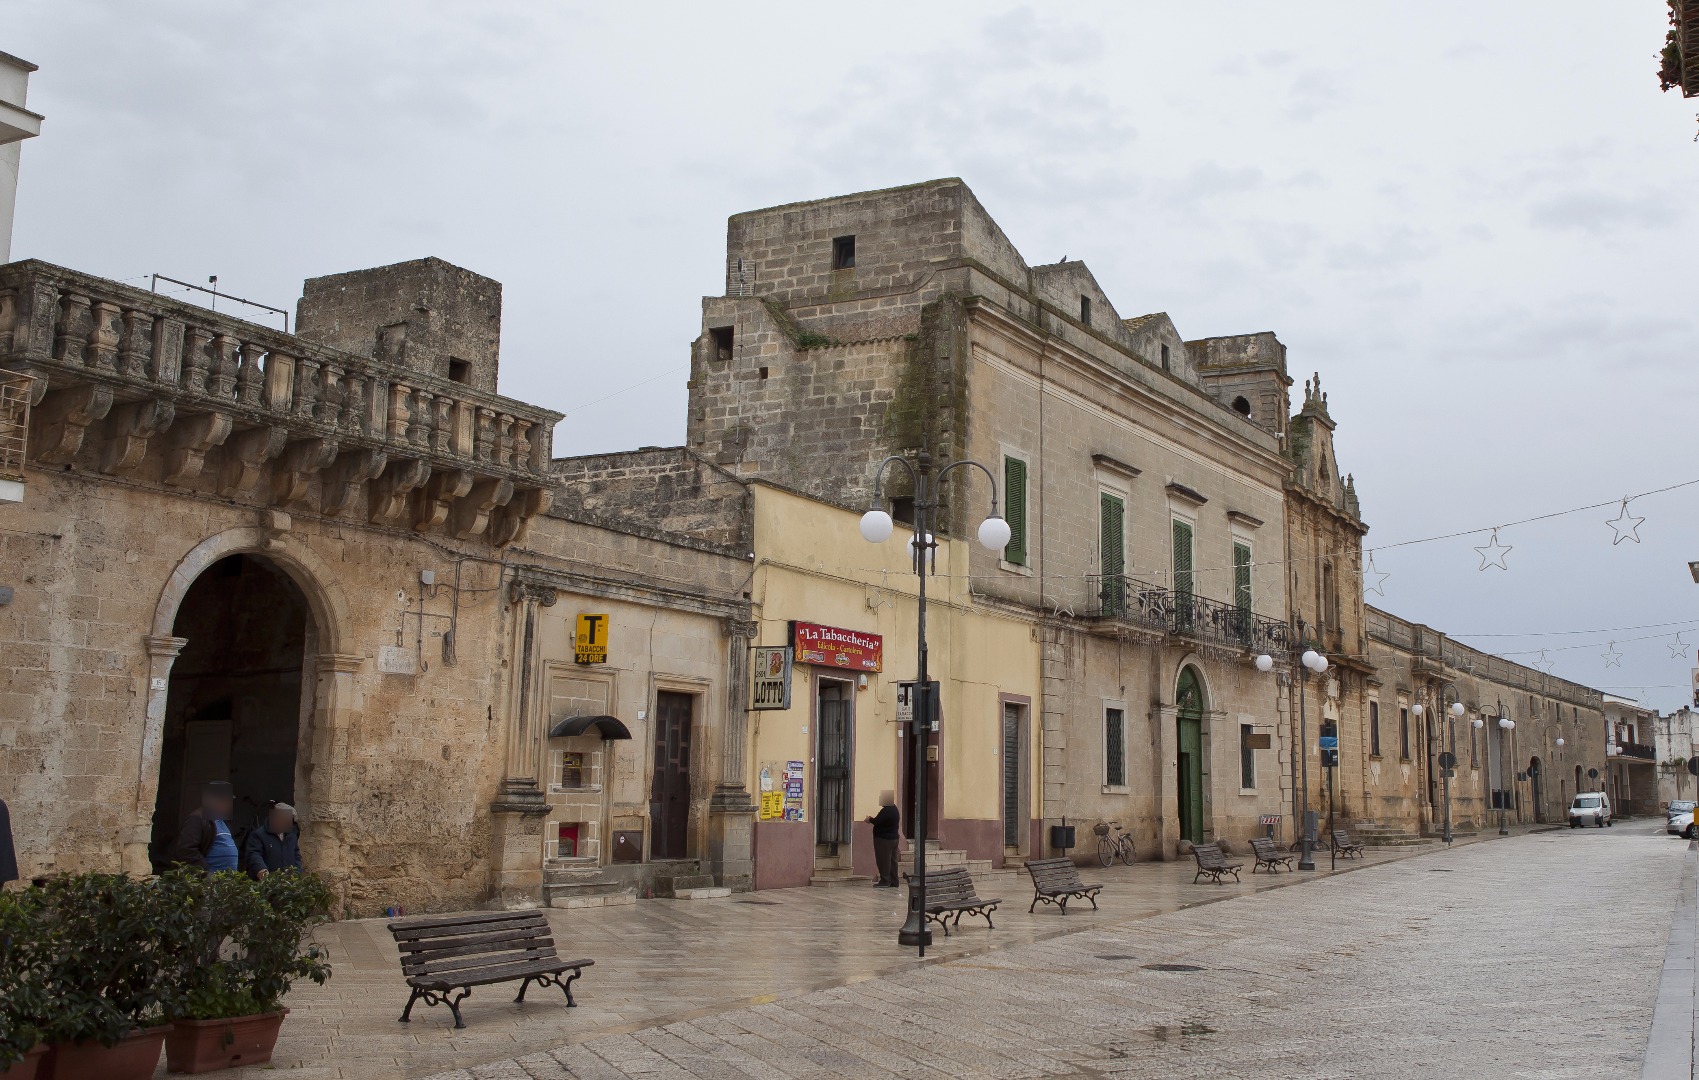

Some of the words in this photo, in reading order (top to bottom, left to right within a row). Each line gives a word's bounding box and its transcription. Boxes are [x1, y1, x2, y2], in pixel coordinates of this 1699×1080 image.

[584, 616, 602, 644] T
[578, 645, 606, 653] TABACCHI
[578, 654, 588, 663] 24
[589, 654, 604, 663] ORE
[755, 681, 784, 704] LOTTO
